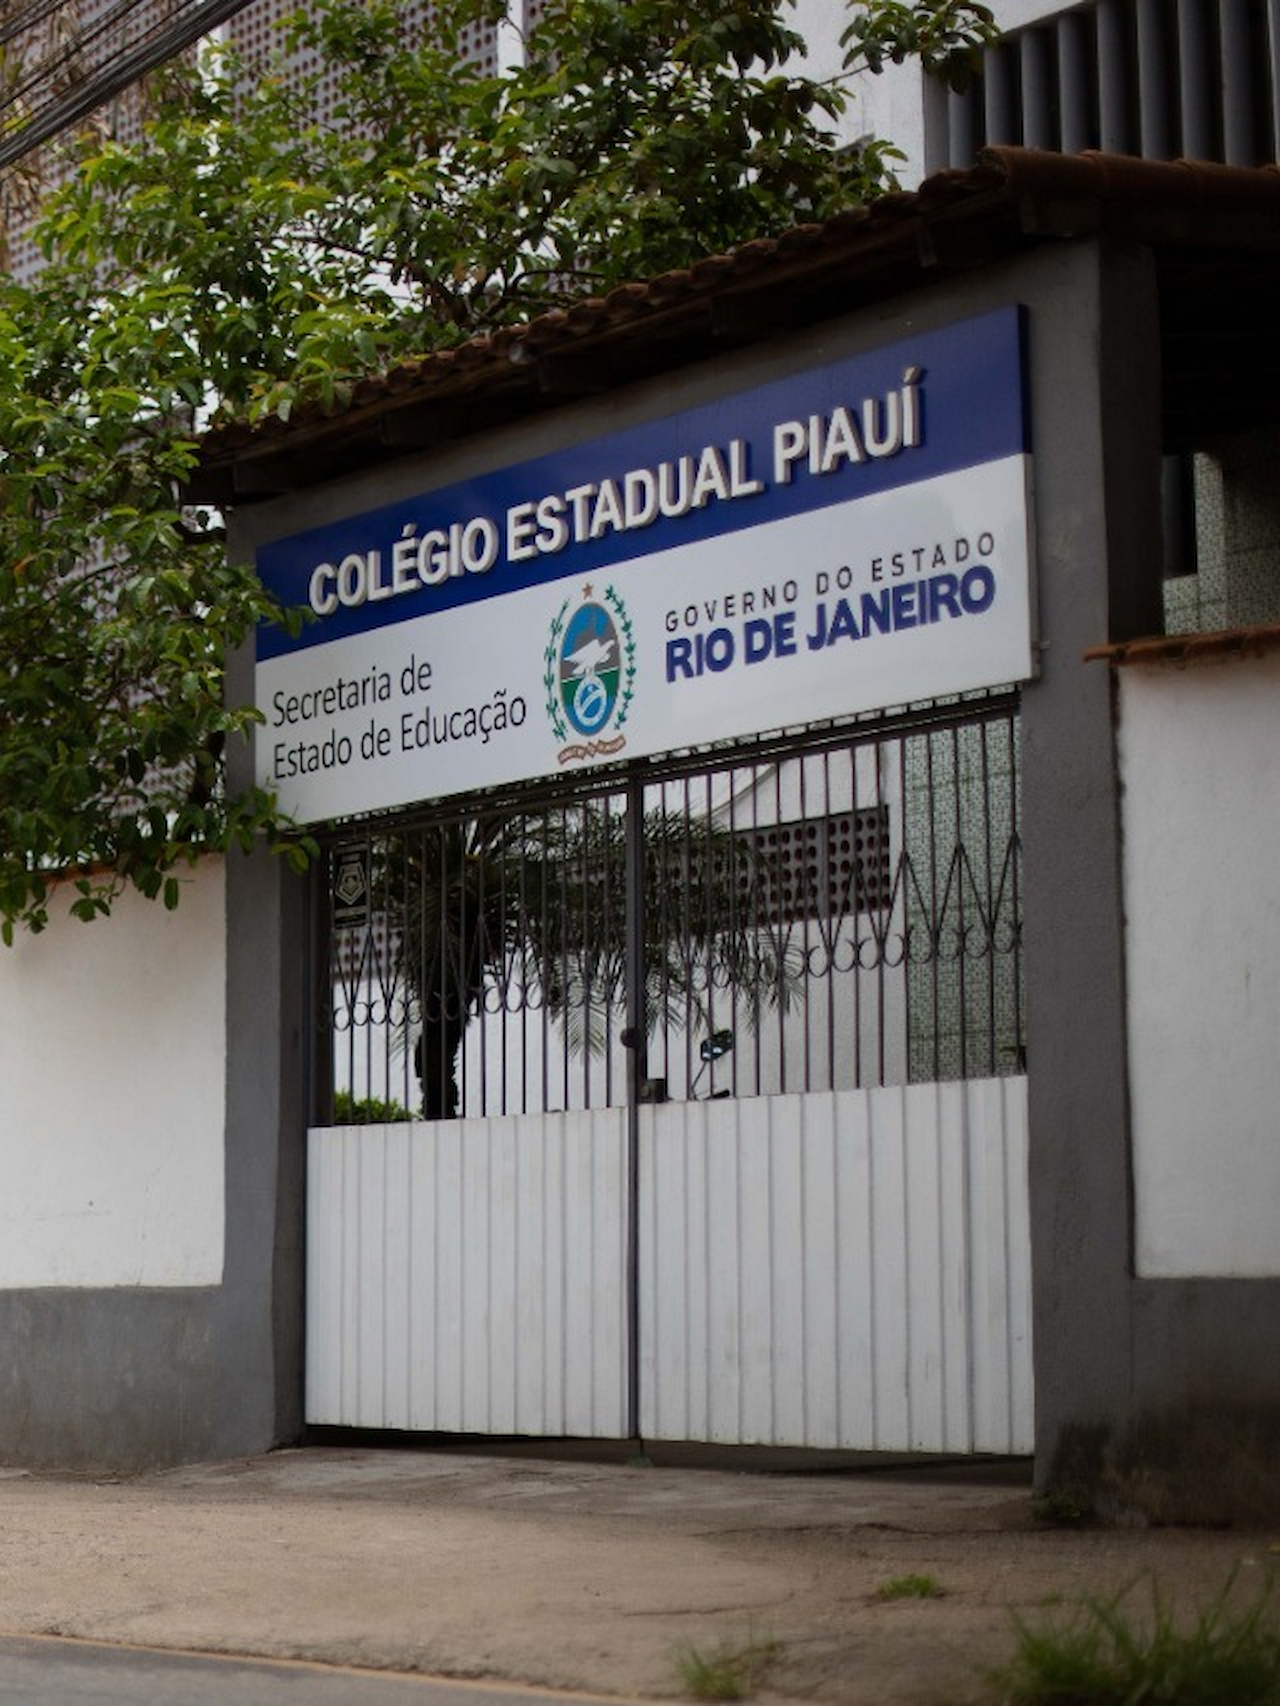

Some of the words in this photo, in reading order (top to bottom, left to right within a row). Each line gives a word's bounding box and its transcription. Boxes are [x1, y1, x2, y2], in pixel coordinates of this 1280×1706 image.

[309, 517, 499, 616] COLÉGIO
[506, 438, 765, 562] ESTADUAL
[773, 366, 925, 485] PIAUÍ
[665, 580, 798, 632] GOVERNO
[816, 566, 853, 595] DO
[871, 532, 995, 582] ESTADO
[666, 628, 735, 683] RIO
[744, 611, 797, 665] DE
[806, 565, 996, 651] JANEIRO
[273, 666, 391, 727] Secretaria
[400, 653, 433, 695] de
[274, 728, 352, 780] Estado
[360, 719, 391, 761] de
[401, 688, 527, 752] Educação
